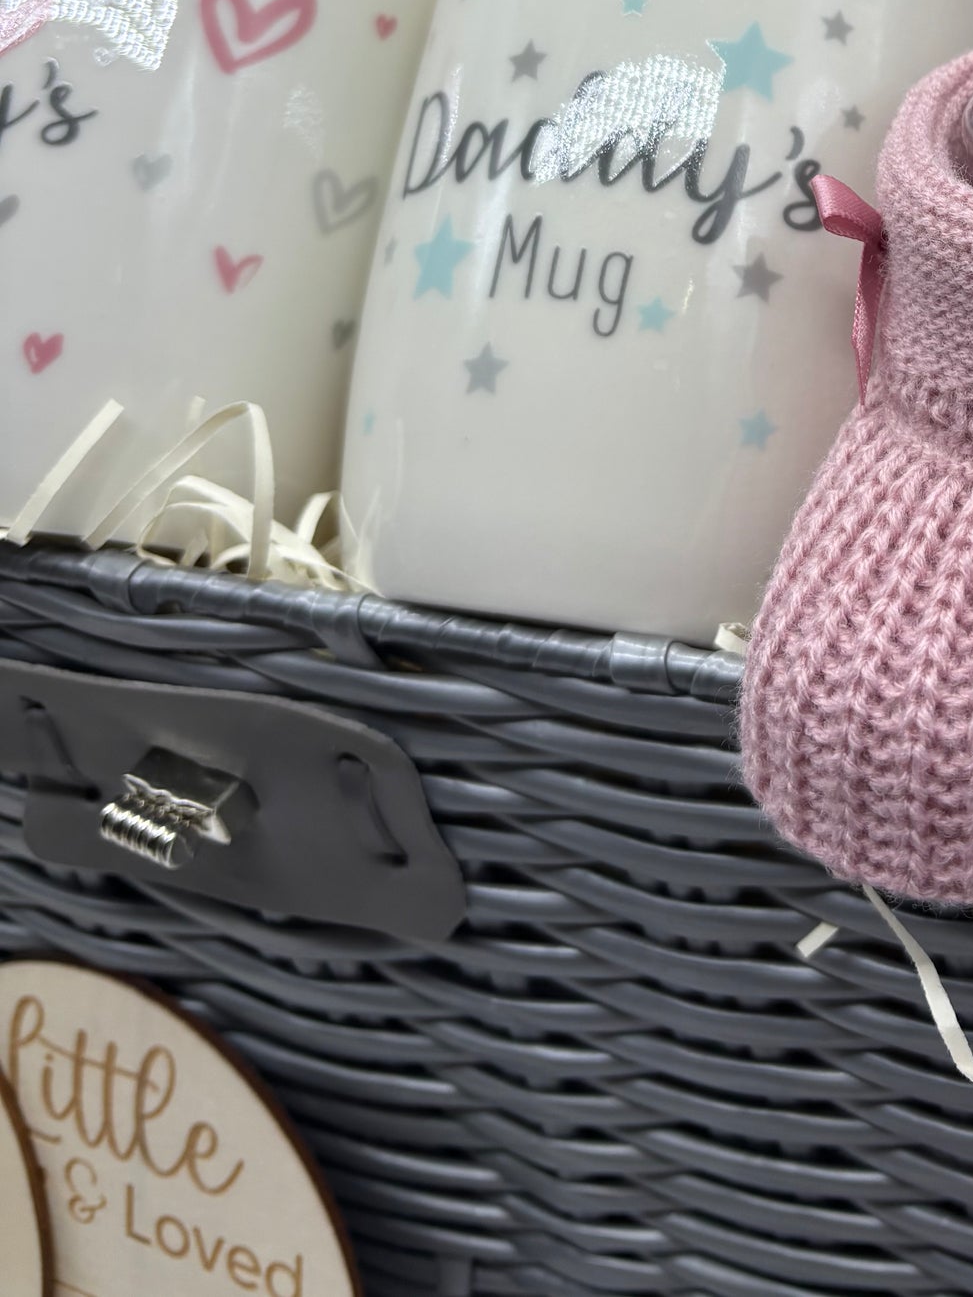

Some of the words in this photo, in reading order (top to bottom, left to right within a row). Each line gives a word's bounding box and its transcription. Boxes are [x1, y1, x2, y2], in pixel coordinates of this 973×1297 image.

[489, 212, 633, 337] Mug
[64, 1157, 107, 1224] &
[125, 1183, 303, 1297] Loved
